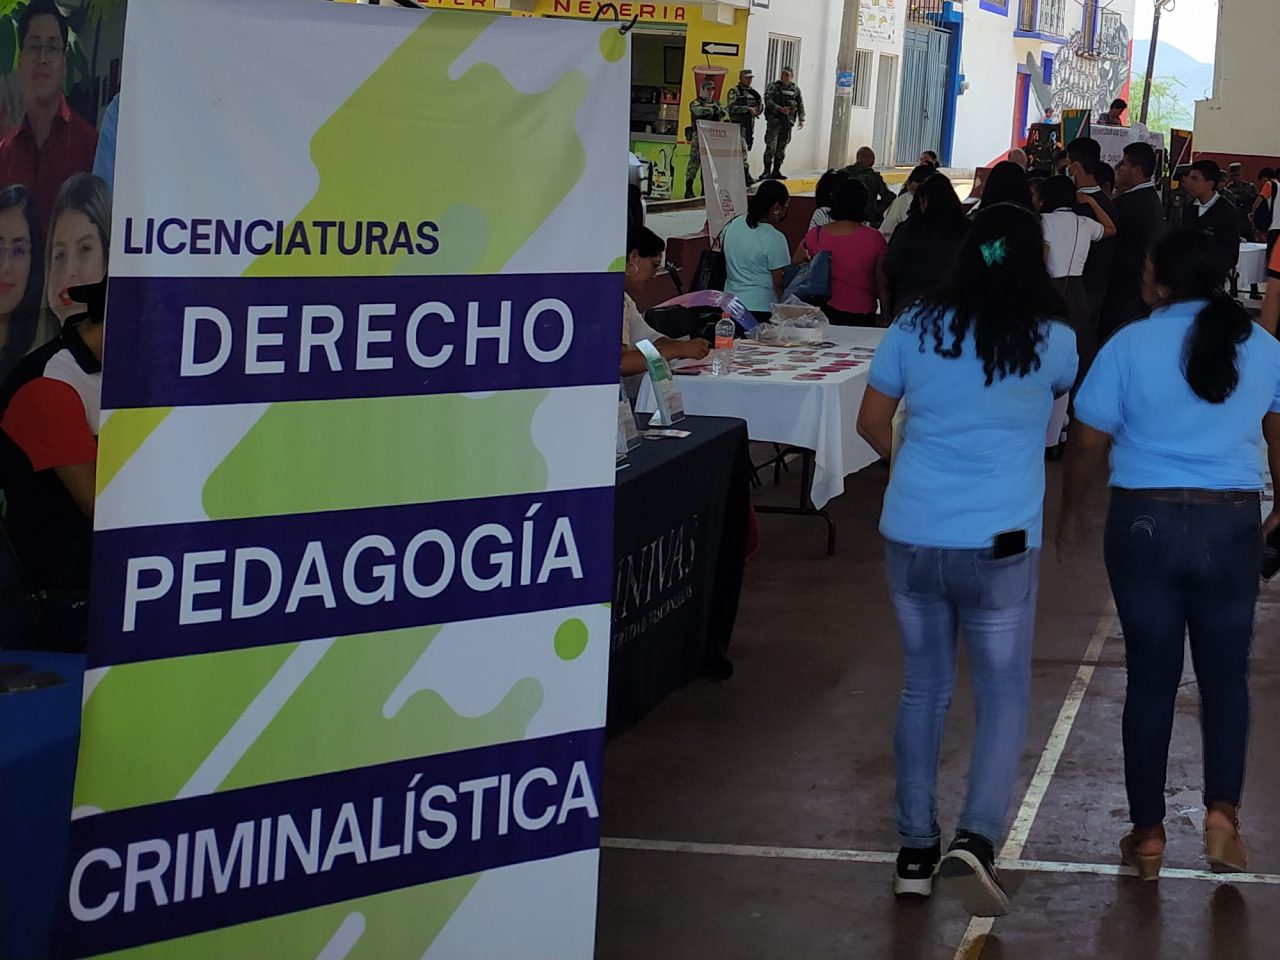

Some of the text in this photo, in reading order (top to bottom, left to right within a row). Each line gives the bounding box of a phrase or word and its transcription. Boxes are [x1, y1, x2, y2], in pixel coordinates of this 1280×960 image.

[123, 216, 440, 256] LICENCIATURAS
[179, 297, 575, 378] DERECHO
[121, 502, 584, 633] PEDAGOGÍA
[67, 760, 600, 923] CRIMINALÍSTICA
